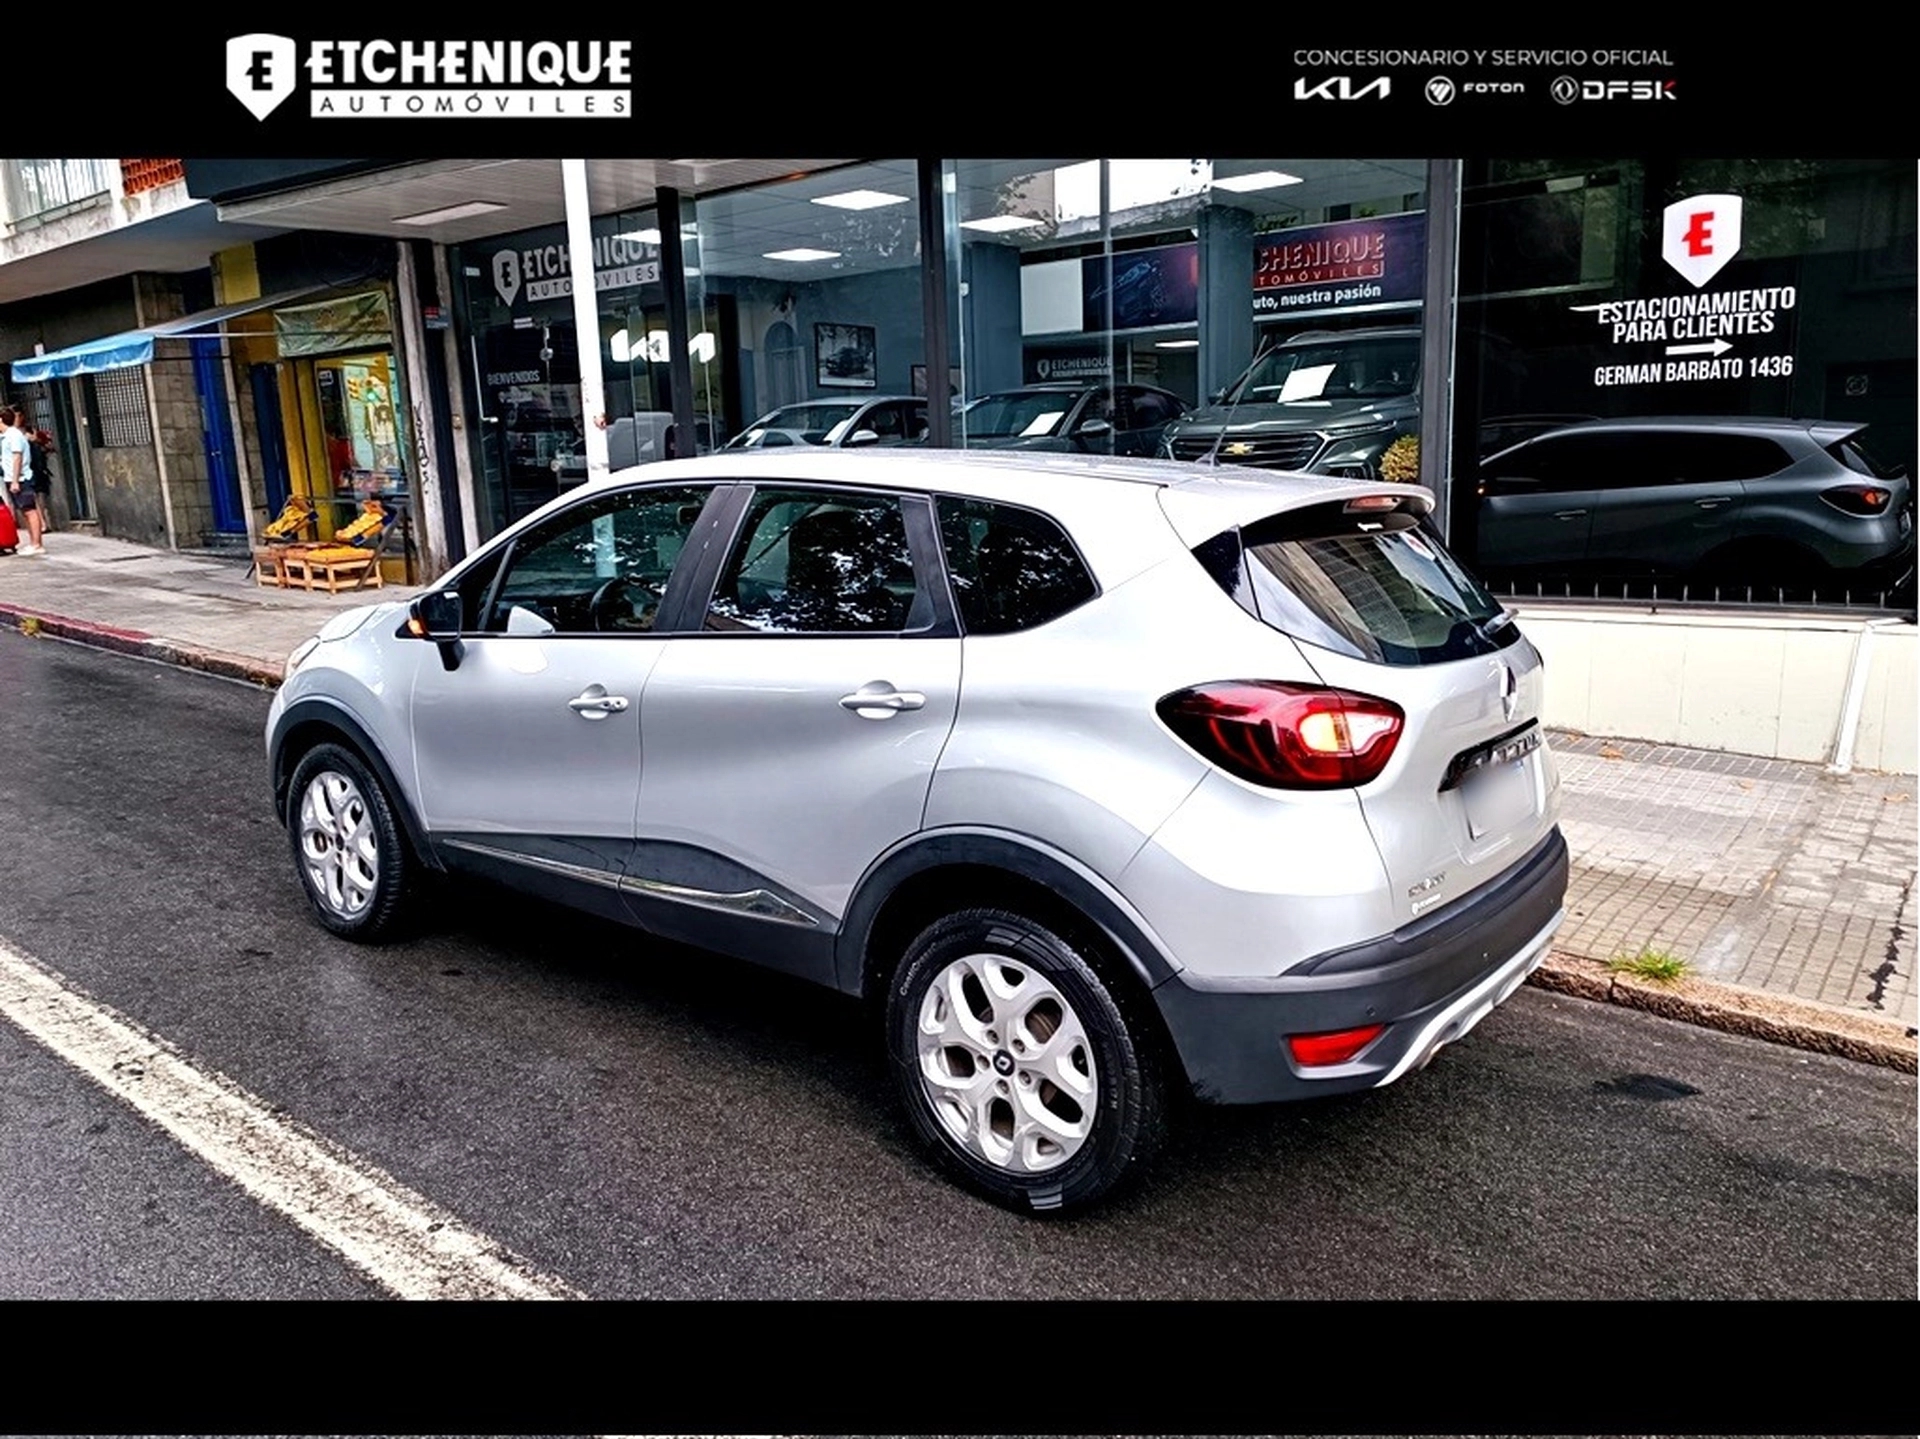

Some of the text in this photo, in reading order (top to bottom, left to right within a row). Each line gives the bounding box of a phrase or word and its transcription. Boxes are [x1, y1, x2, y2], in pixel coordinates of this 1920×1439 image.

[523, 234, 659, 279] ETCHNIQUE
[1255, 232, 1385, 272] CHENIQUE
[530, 266, 655, 298] AUTOVILES
[1254, 263, 1380, 286] TOMÓVILES
[1253, 282, 1382, 310] uto, nuestra pasión
[1598, 286, 1796, 324] ESTACIONAMIENTO
[1612, 311, 1775, 344] PARA CLIENTES
[1594, 355, 1794, 386] GERMAN BARBATO 1436
